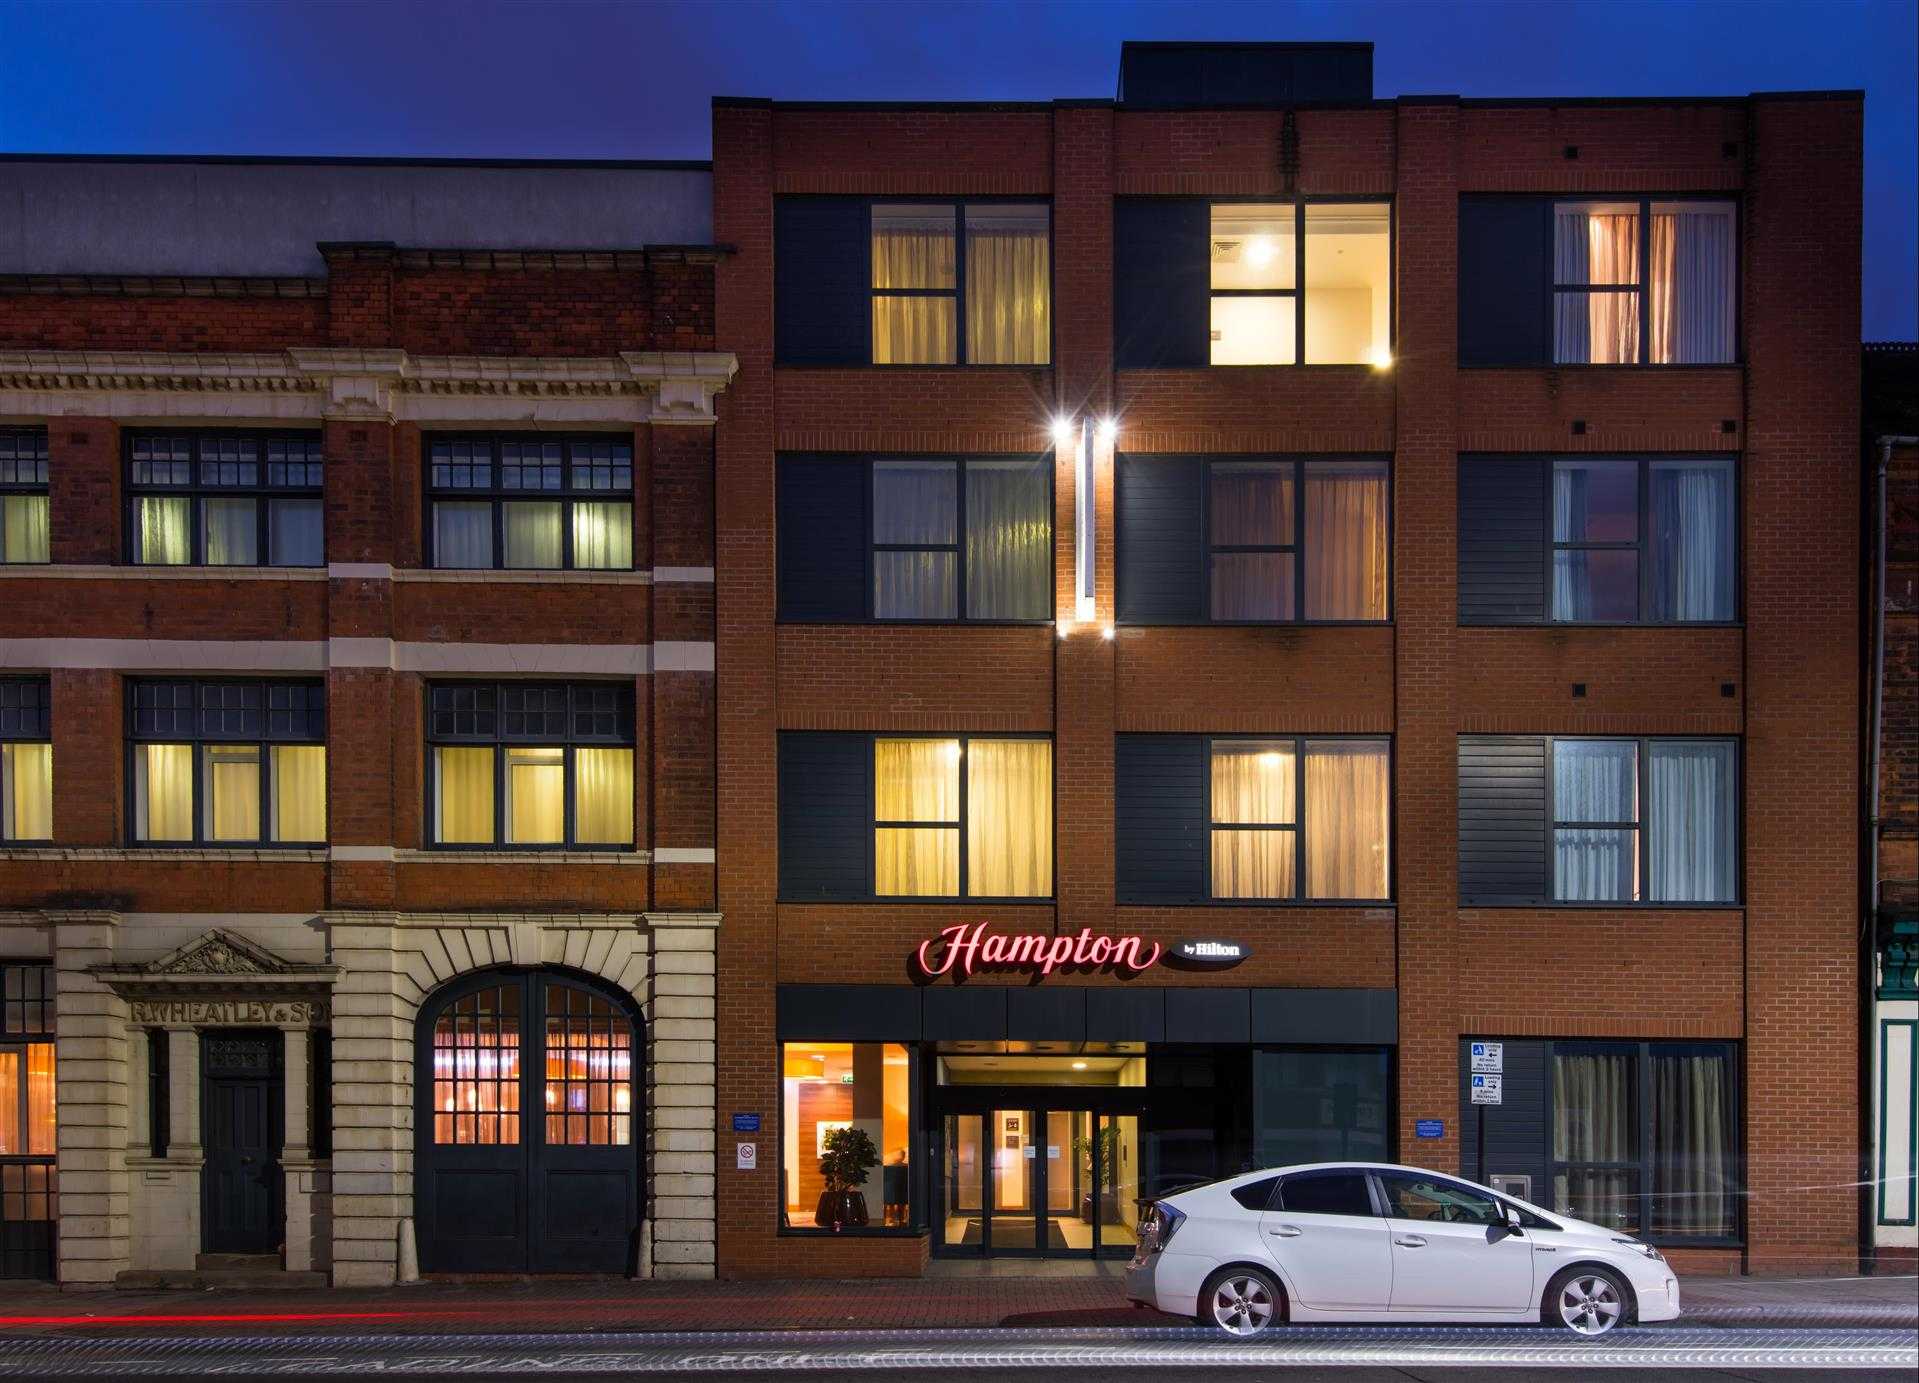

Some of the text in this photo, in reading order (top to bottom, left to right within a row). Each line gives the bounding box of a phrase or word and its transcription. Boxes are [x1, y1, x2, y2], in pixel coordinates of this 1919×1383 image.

[919, 921, 1160, 976] Hampton
[1184, 942, 1240, 956] by Hilton
